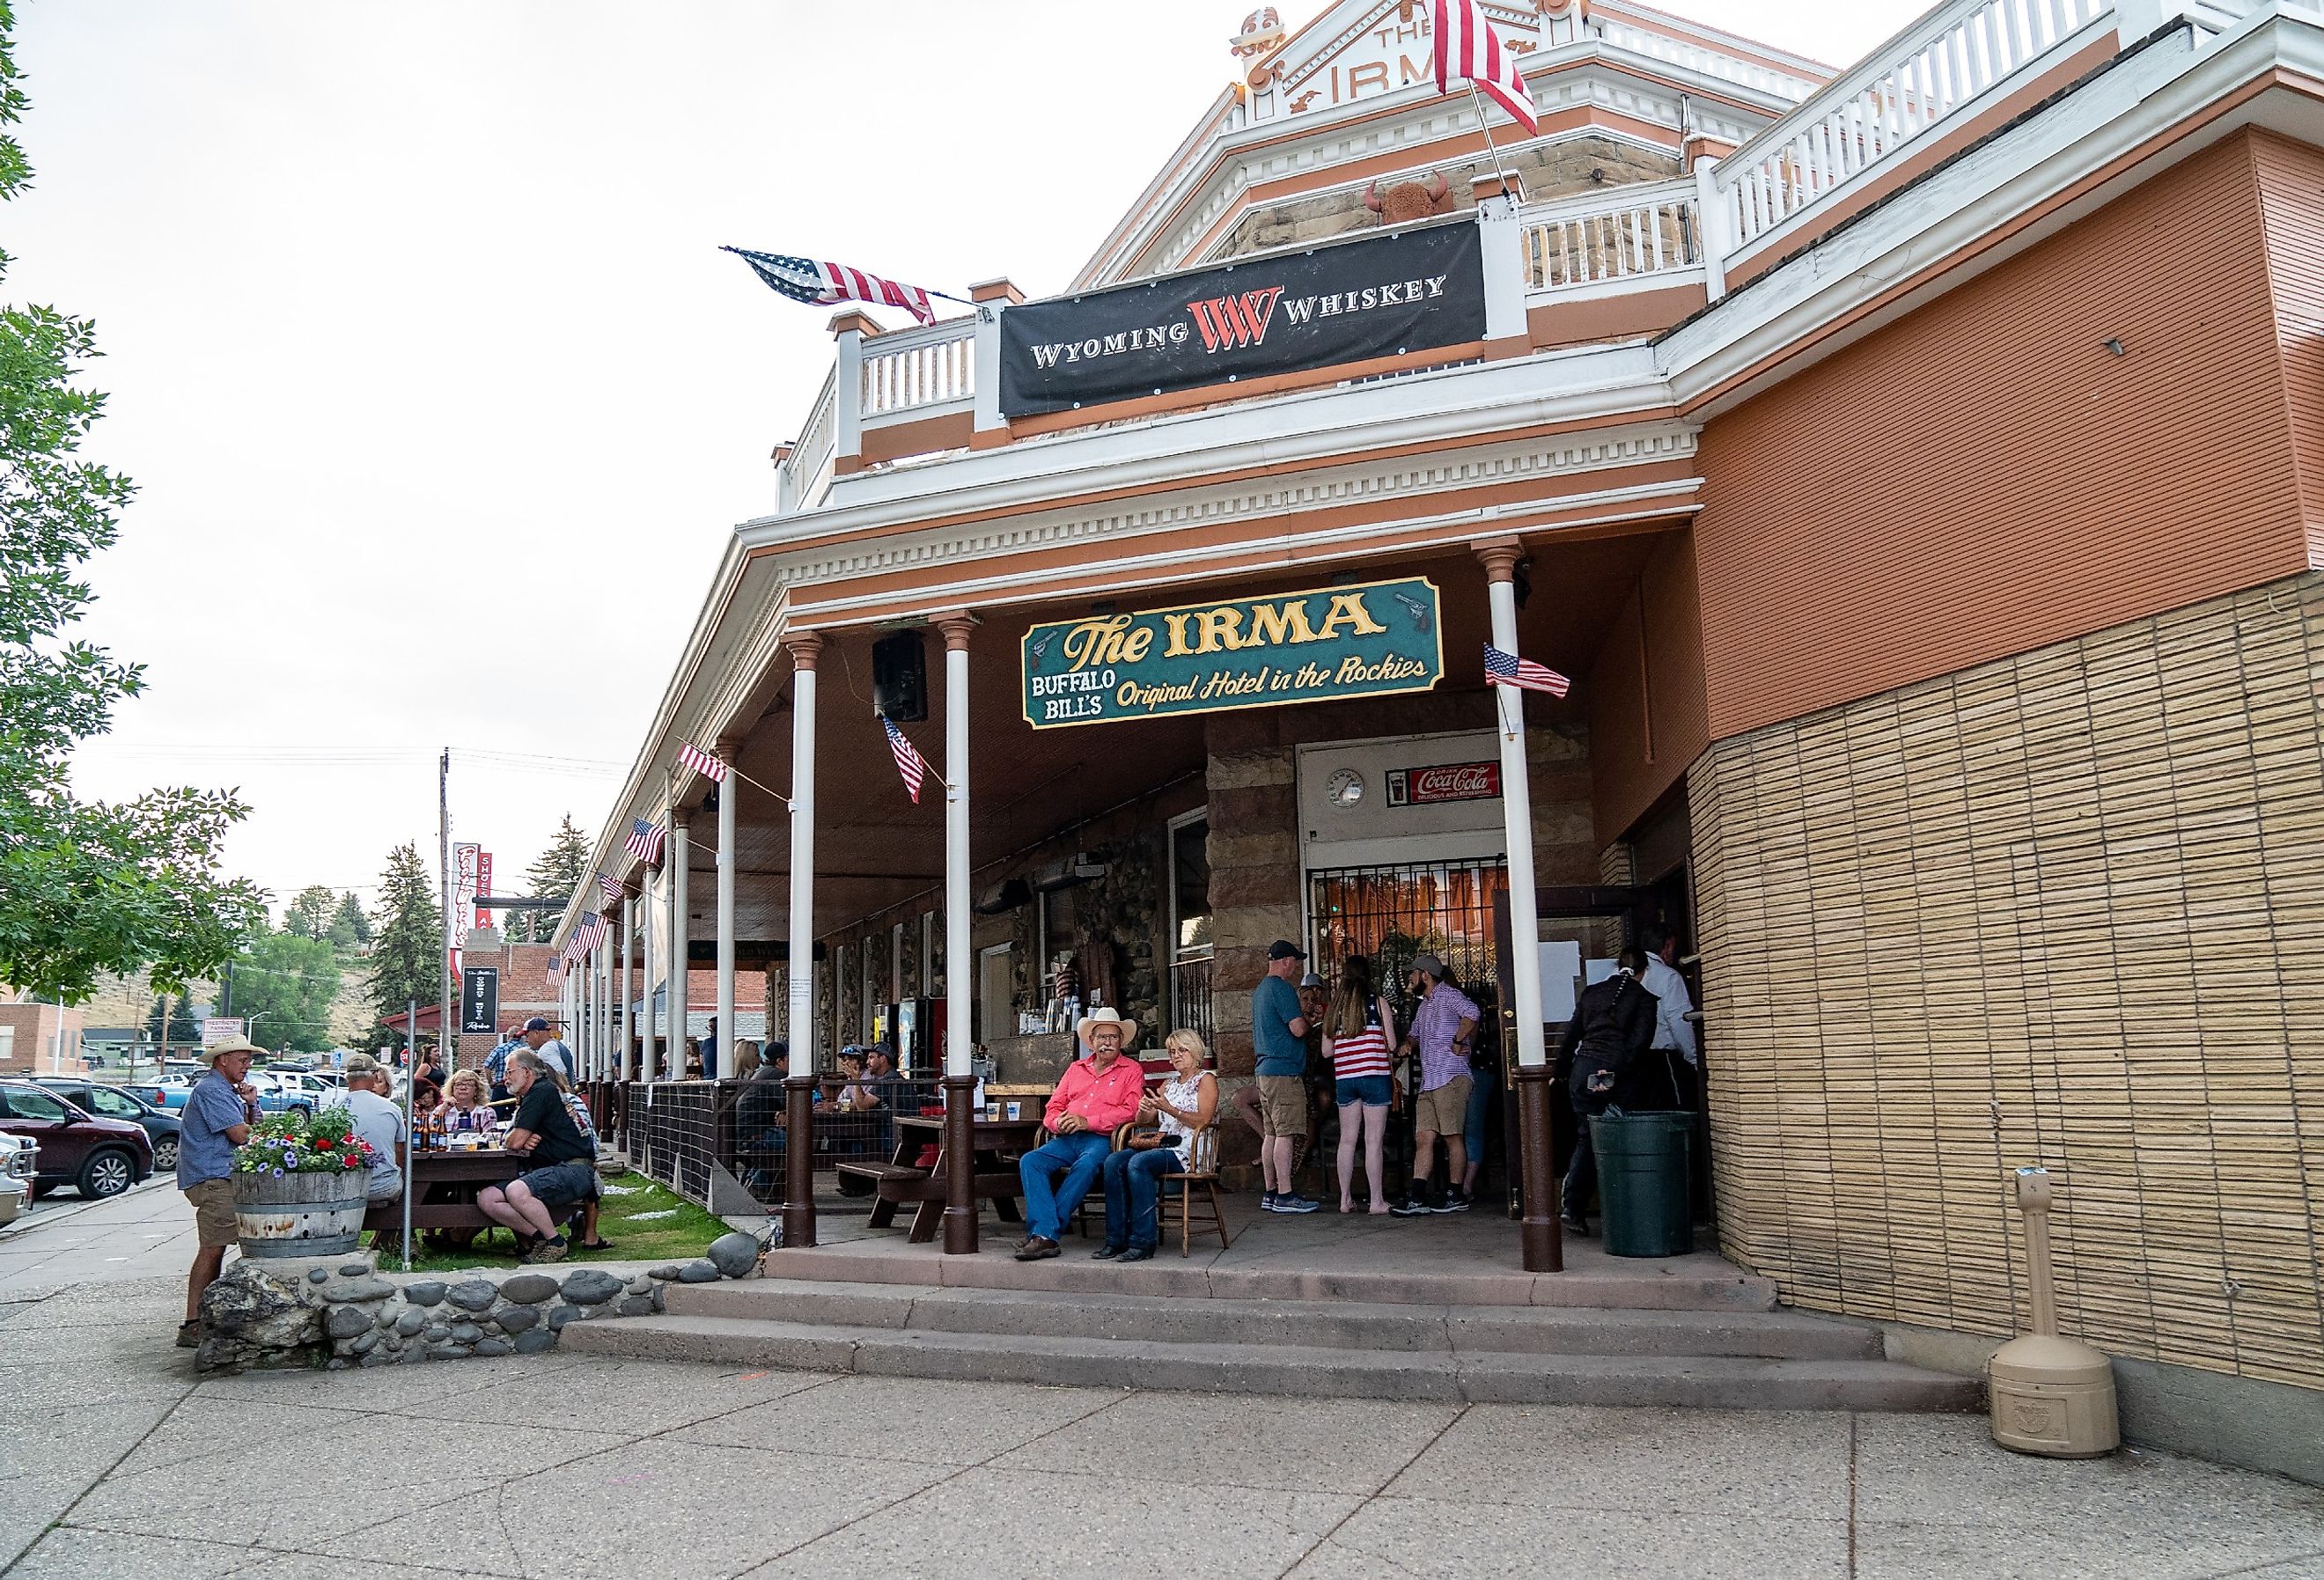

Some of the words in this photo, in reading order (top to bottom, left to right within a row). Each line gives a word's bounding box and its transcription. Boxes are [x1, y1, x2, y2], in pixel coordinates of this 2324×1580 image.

[1373, 18, 1432, 48] THE
[1331, 48, 1434, 104] IRM
[1030, 321, 1189, 369] WYOMING
[1283, 275, 1446, 325] WHISKEY
[1063, 612, 1154, 672] The
[1164, 592, 1387, 658] IRMA
[1032, 669, 1116, 697] BUFFALO
[1045, 694, 1102, 720] BILL'S
[1116, 675, 1200, 711] Original
[1200, 666, 1269, 700] Hotel
[1270, 669, 1290, 690] in
[1294, 661, 1330, 688] the
[1335, 653, 1428, 684] Rockies
